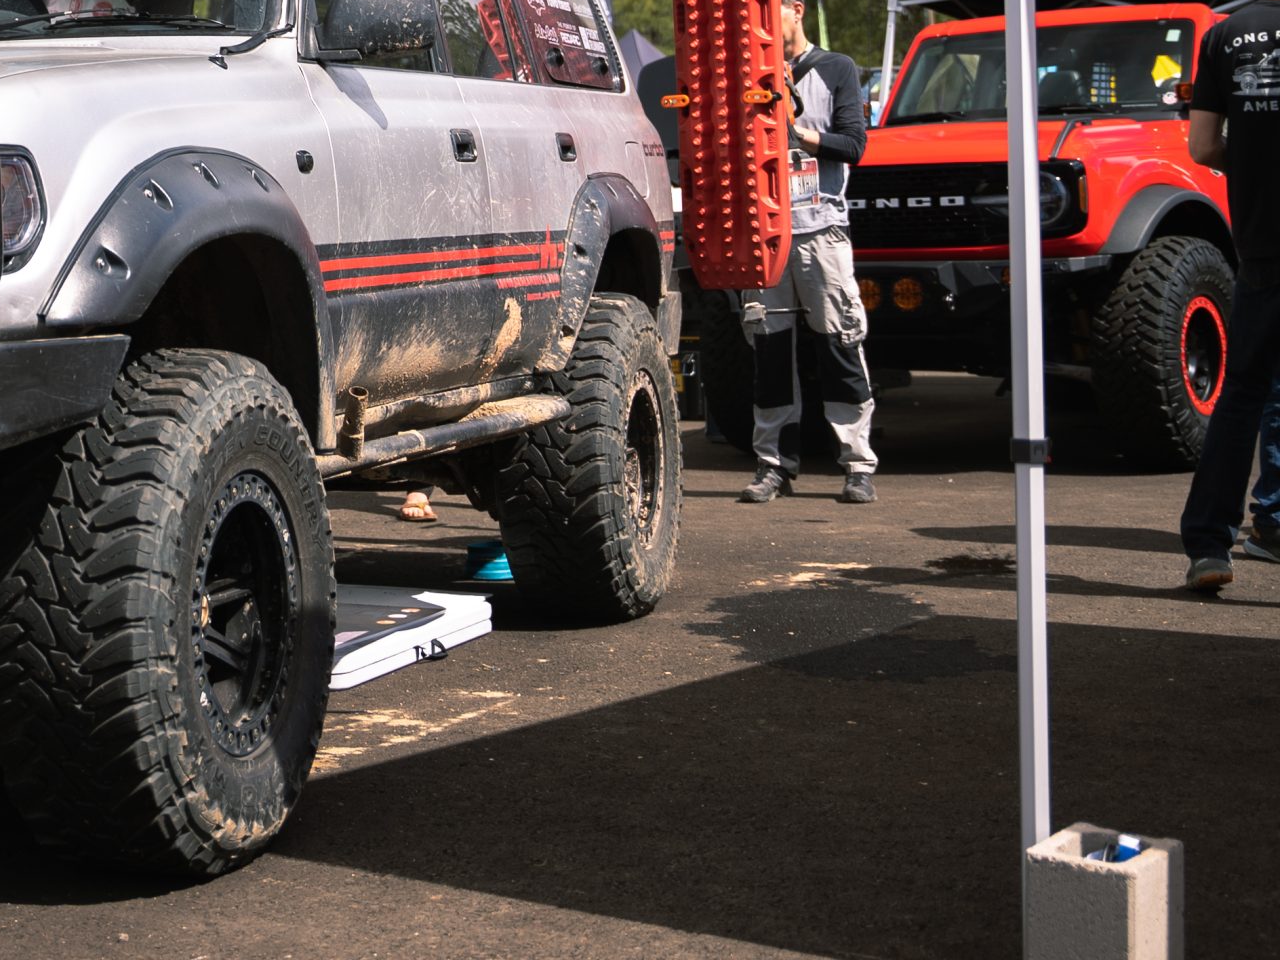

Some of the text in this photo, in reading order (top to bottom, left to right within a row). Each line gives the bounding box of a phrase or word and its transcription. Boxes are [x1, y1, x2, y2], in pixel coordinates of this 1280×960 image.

[1224, 32, 1269, 54] LONG
[1243, 100, 1280, 112] AME
[847, 195, 966, 209] ONCO
